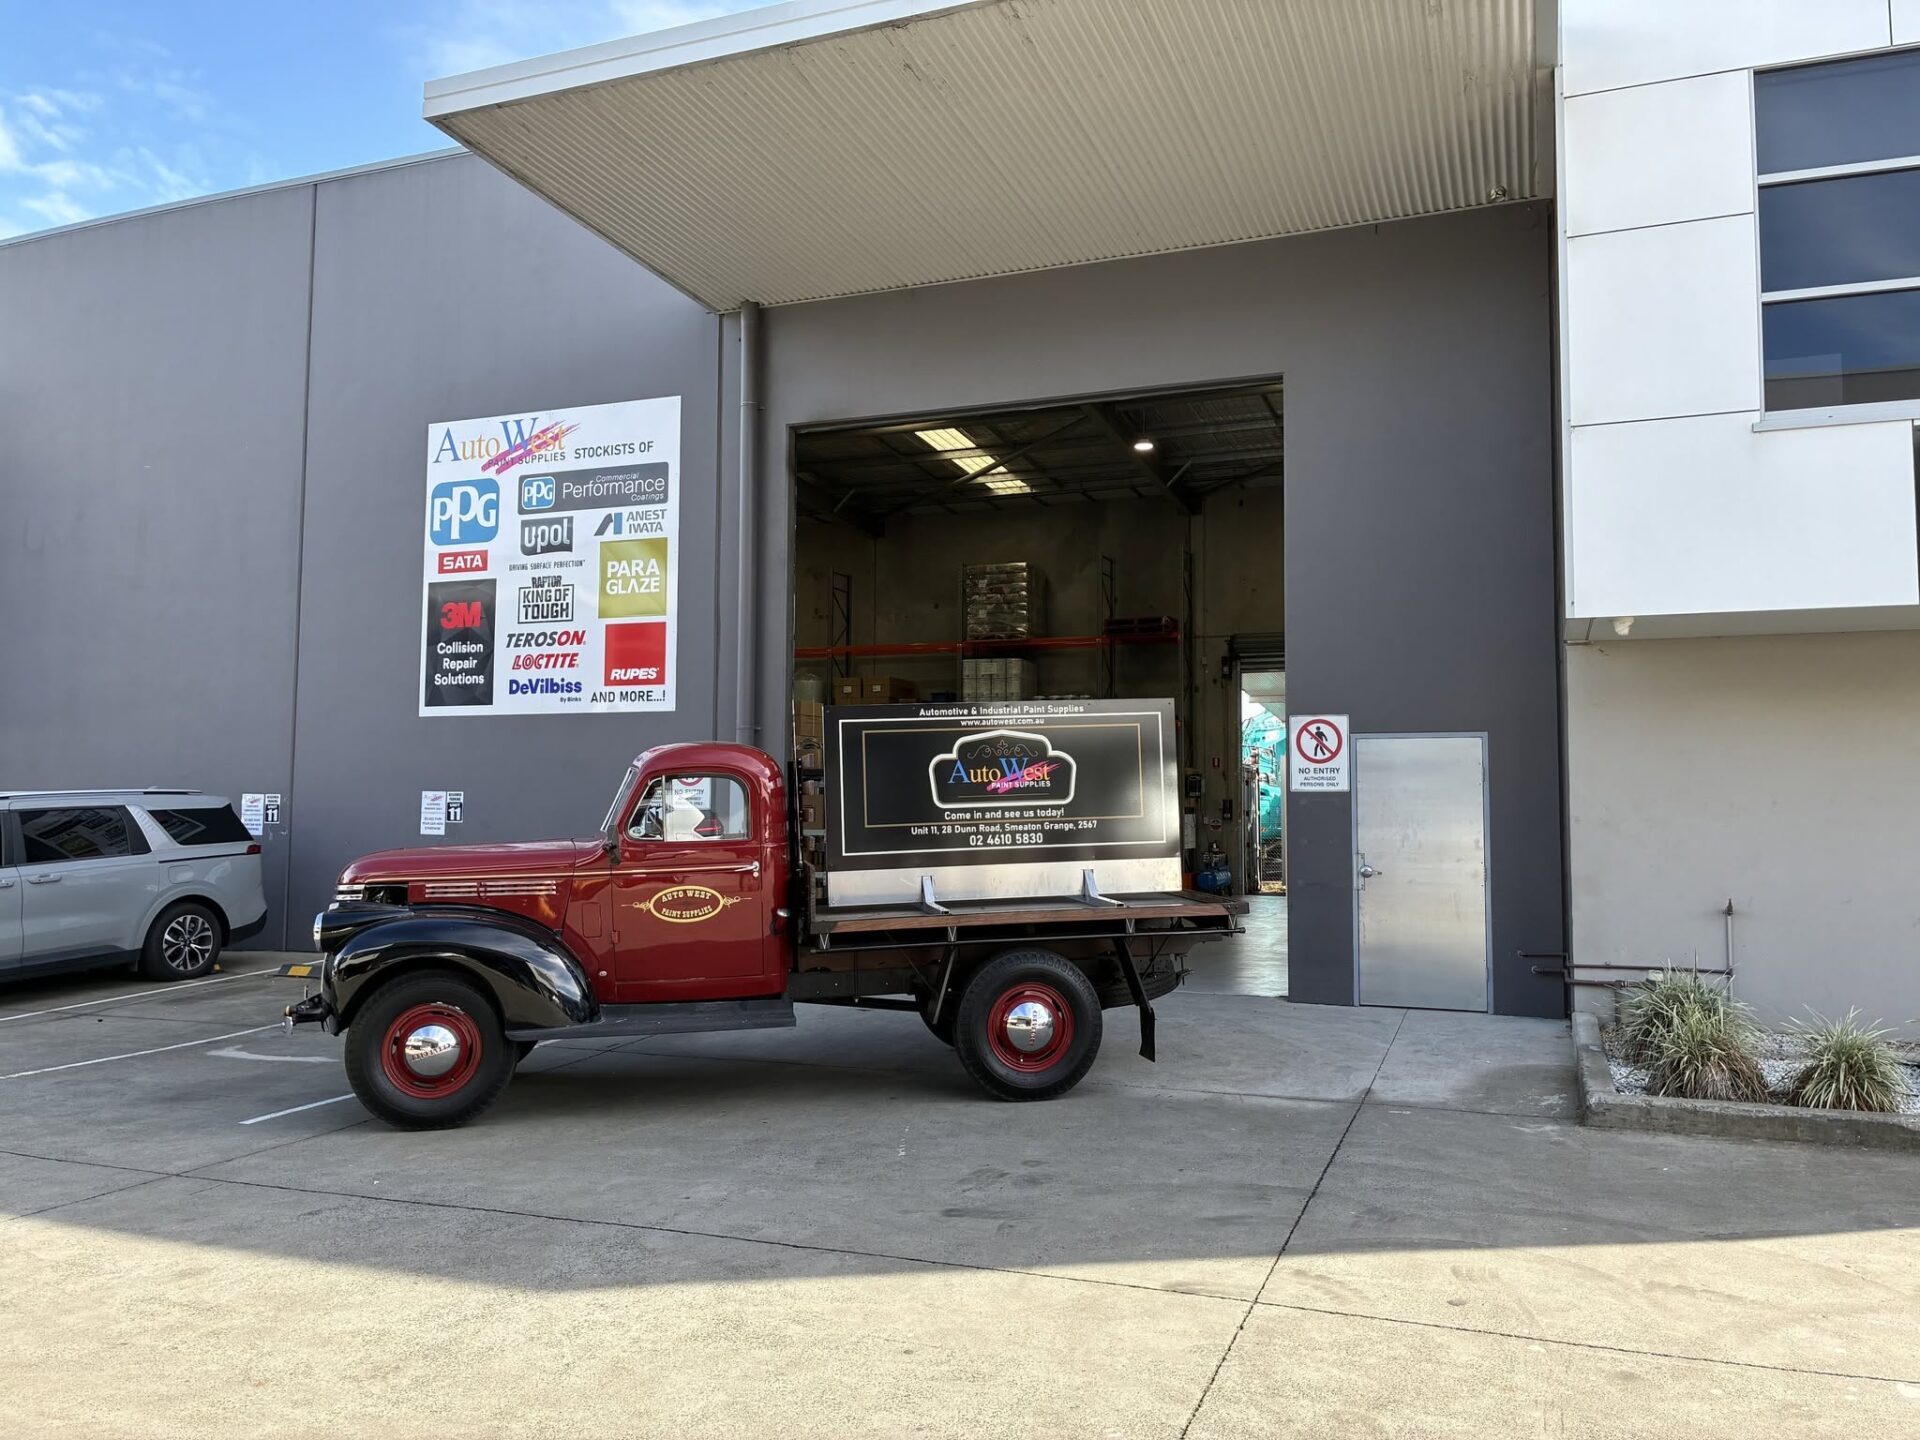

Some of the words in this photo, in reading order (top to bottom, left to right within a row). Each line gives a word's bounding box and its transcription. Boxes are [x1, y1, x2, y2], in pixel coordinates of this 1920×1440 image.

[574, 442, 635, 459] STOCKISTS
[638, 440, 654, 453] OF
[519, 451, 566, 465] SUPPLIES
[595, 472, 640, 483] Commercial
[524, 480, 554, 506] PPG
[562, 477, 665, 499] Performance
[631, 492, 665, 502] Coatings
[433, 485, 497, 540] PPG
[626, 509, 667, 522] ANEST
[628, 522, 663, 535] IWATA
[443, 556, 483, 570] SATA
[508, 563, 528, 571] DRIVING
[530, 561, 552, 570] SURFACE
[606, 558, 660, 578] PARA
[531, 575, 562, 589] RAPTOR
[606, 577, 660, 595] GLAZE
[523, 589, 552, 603] KING
[554, 588, 570, 602] OF
[440, 601, 482, 630] 3M
[523, 602, 570, 620] TOUGH
[506, 630, 586, 648] TEROSON
[437, 641, 483, 654] Collision
[443, 658, 478, 671] Repair
[512, 652, 579, 670] LOCTITE
[434, 673, 485, 686] Solutions
[610, 667, 657, 681] RUPES
[509, 678, 583, 695] DeVilbiss
[590, 691, 616, 704] AND
[619, 689, 666, 703] MORE...!
[919, 707, 969, 717] Automotive
[971, 707, 978, 715] &
[979, 705, 1021, 714] Industrial
[1023, 705, 1045, 714] Paint
[1047, 704, 1085, 715] Supplies
[960, 717, 1045, 727] www.autowest.com.au
[1298, 767, 1311, 775] NO
[1313, 767, 1341, 775] ENTRY
[991, 781, 1013, 789] PAINT
[1014, 780, 1051, 788] SUPPLIES
[266, 809, 278, 822] 11
[448, 807, 461, 821] 11
[944, 811, 971, 820] Come
[973, 810, 982, 819] in
[984, 809, 1002, 819] and
[1004, 810, 1021, 818] see
[1023, 810, 1034, 818] us
[1037, 807, 1065, 819] today!
[911, 826, 929, 835] Unit
[930, 826, 940, 836] 11,
[941, 825, 952, 834] 28
[954, 824, 977, 833] Dunn
[979, 823, 1002, 833] Road,
[1004, 822, 1041, 832] Smeaton
[1043, 821, 1076, 832] Grange,
[1078, 820, 1098, 829] 2567
[969, 834, 983, 846] 02
[986, 833, 1012, 845] 4610
[1015, 832, 1044, 845] 5830
[661, 890, 684, 903] AUTO
[686, 889, 712, 900] WEST
[661, 907, 681, 918] PAINT
[682, 905, 713, 918] SUPPLIES
